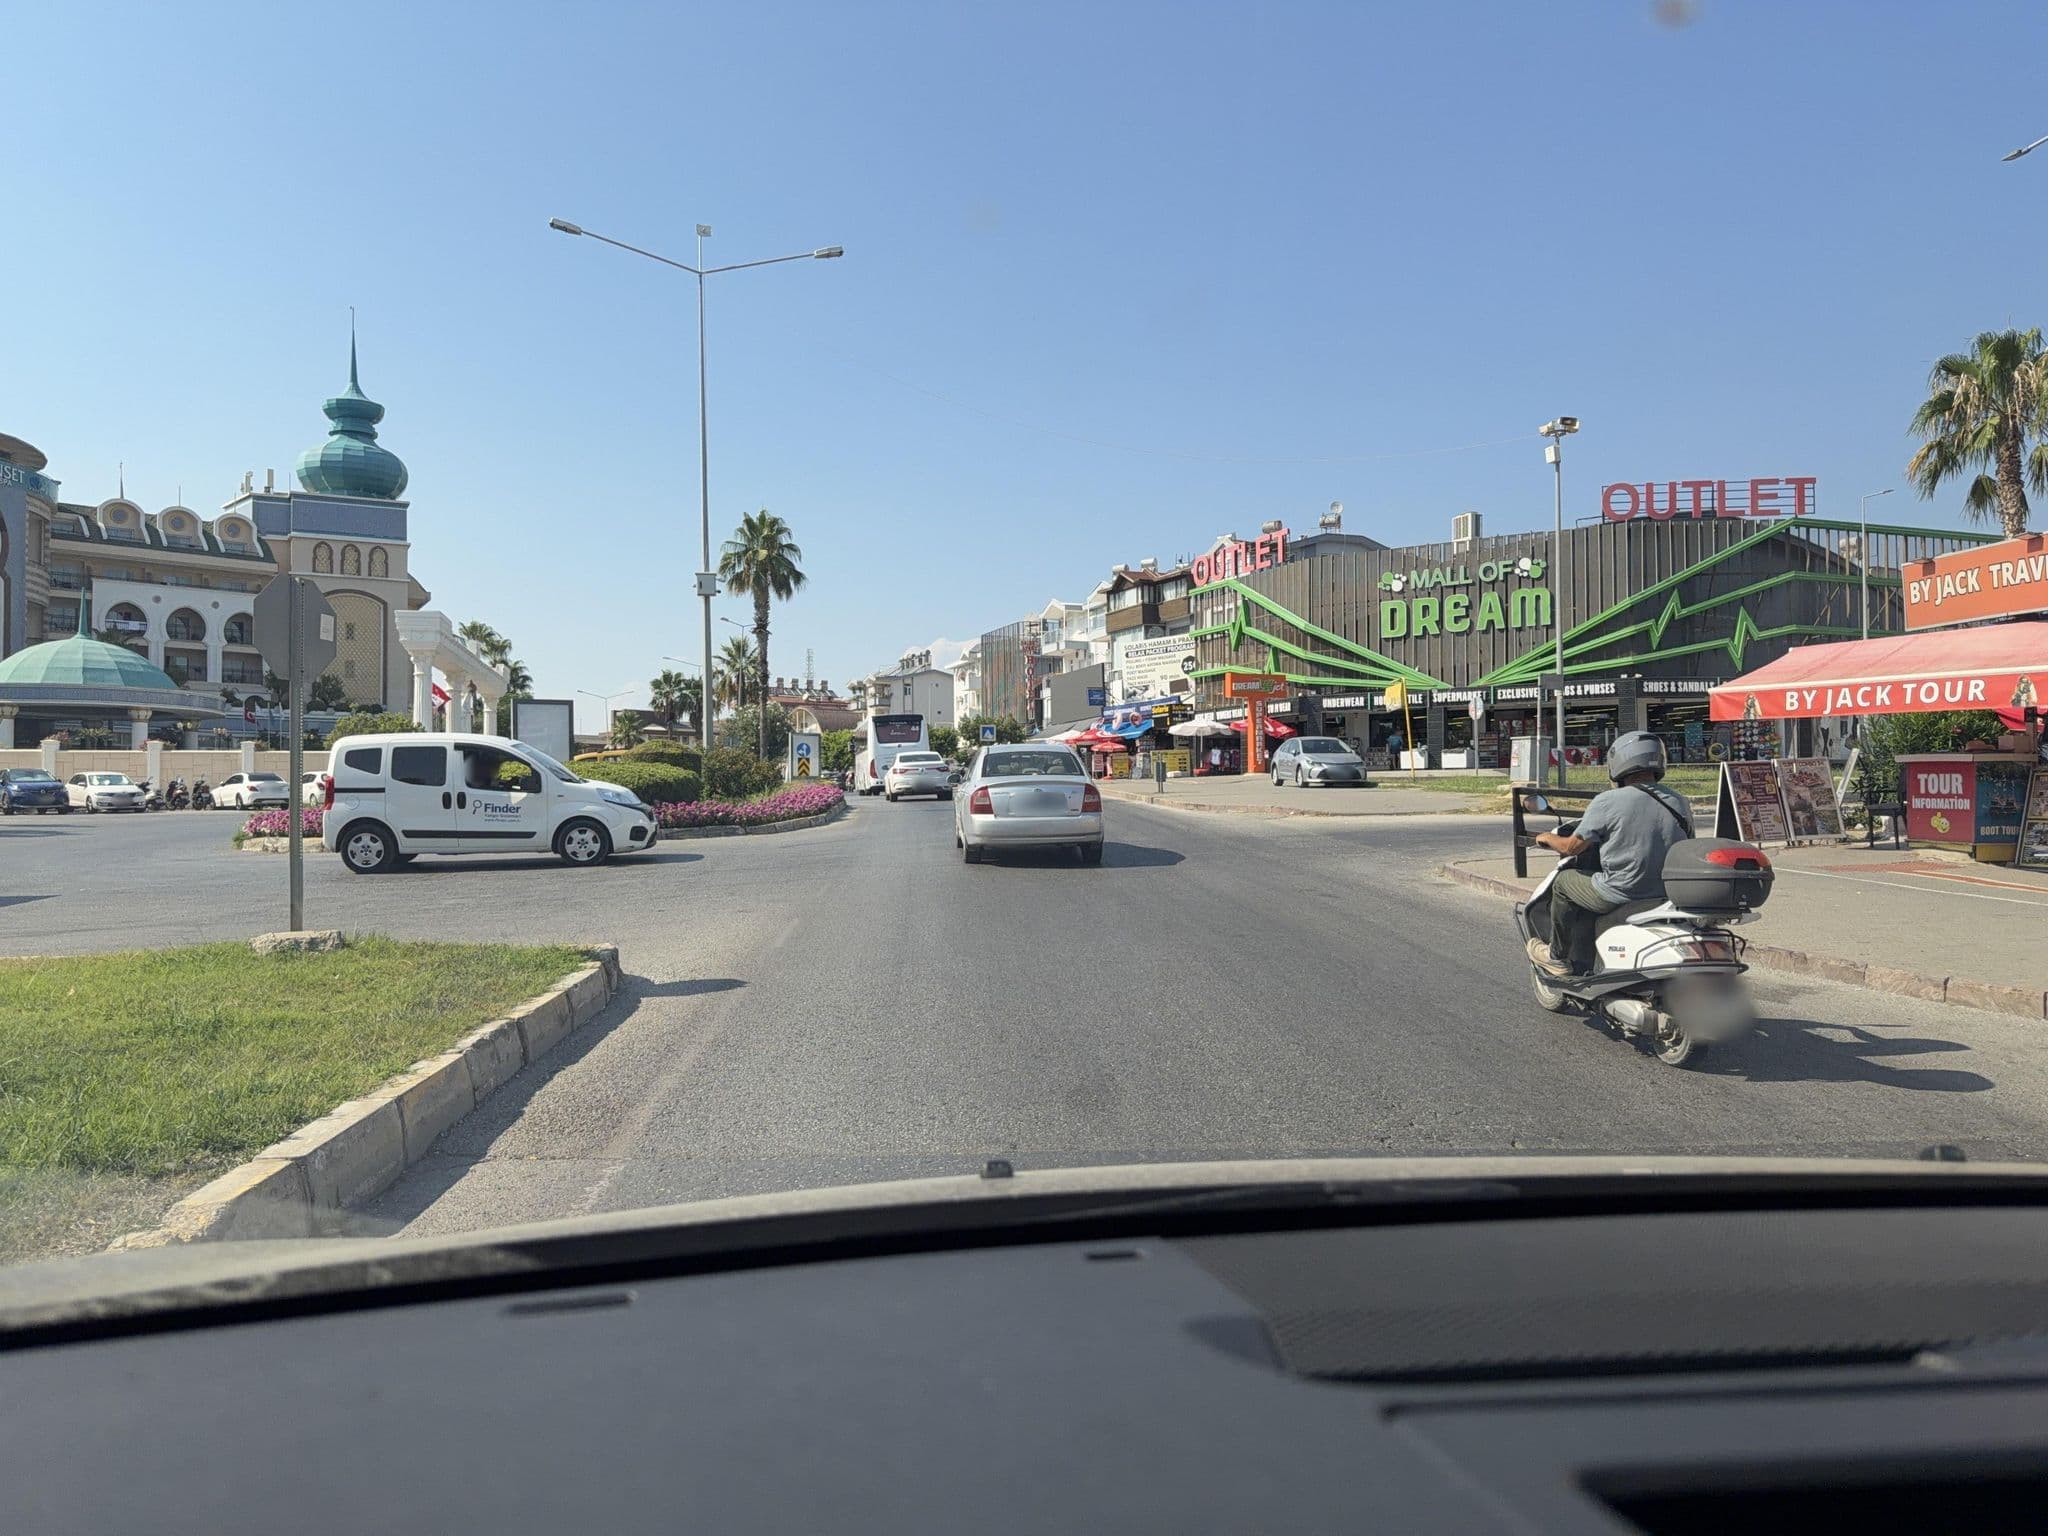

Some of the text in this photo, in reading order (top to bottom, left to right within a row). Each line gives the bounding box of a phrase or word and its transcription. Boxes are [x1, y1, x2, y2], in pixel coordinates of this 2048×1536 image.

[1602, 477, 1816, 521] OUTLET
[1191, 528, 1290, 587] OUTLET
[1410, 560, 1514, 590] MALL OF
[1909, 578, 1931, 605] BY
[1935, 567, 1981, 606] JACK
[1380, 587, 1551, 639] DREAM
[1232, 681, 1260, 691] DREAM
[1497, 687, 1539, 700] EXCLUSIVE
[1576, 686, 1583, 696] &
[1584, 683, 1616, 695] PURSES
[1643, 680, 1715, 693] SHOES & SANDALS
[1784, 679, 1986, 715] BY JACK TOUR
[1322, 697, 1364, 708] UNDERWEAR
[1917, 773, 1963, 795] TOUR
[484, 803, 522, 814] Finder
